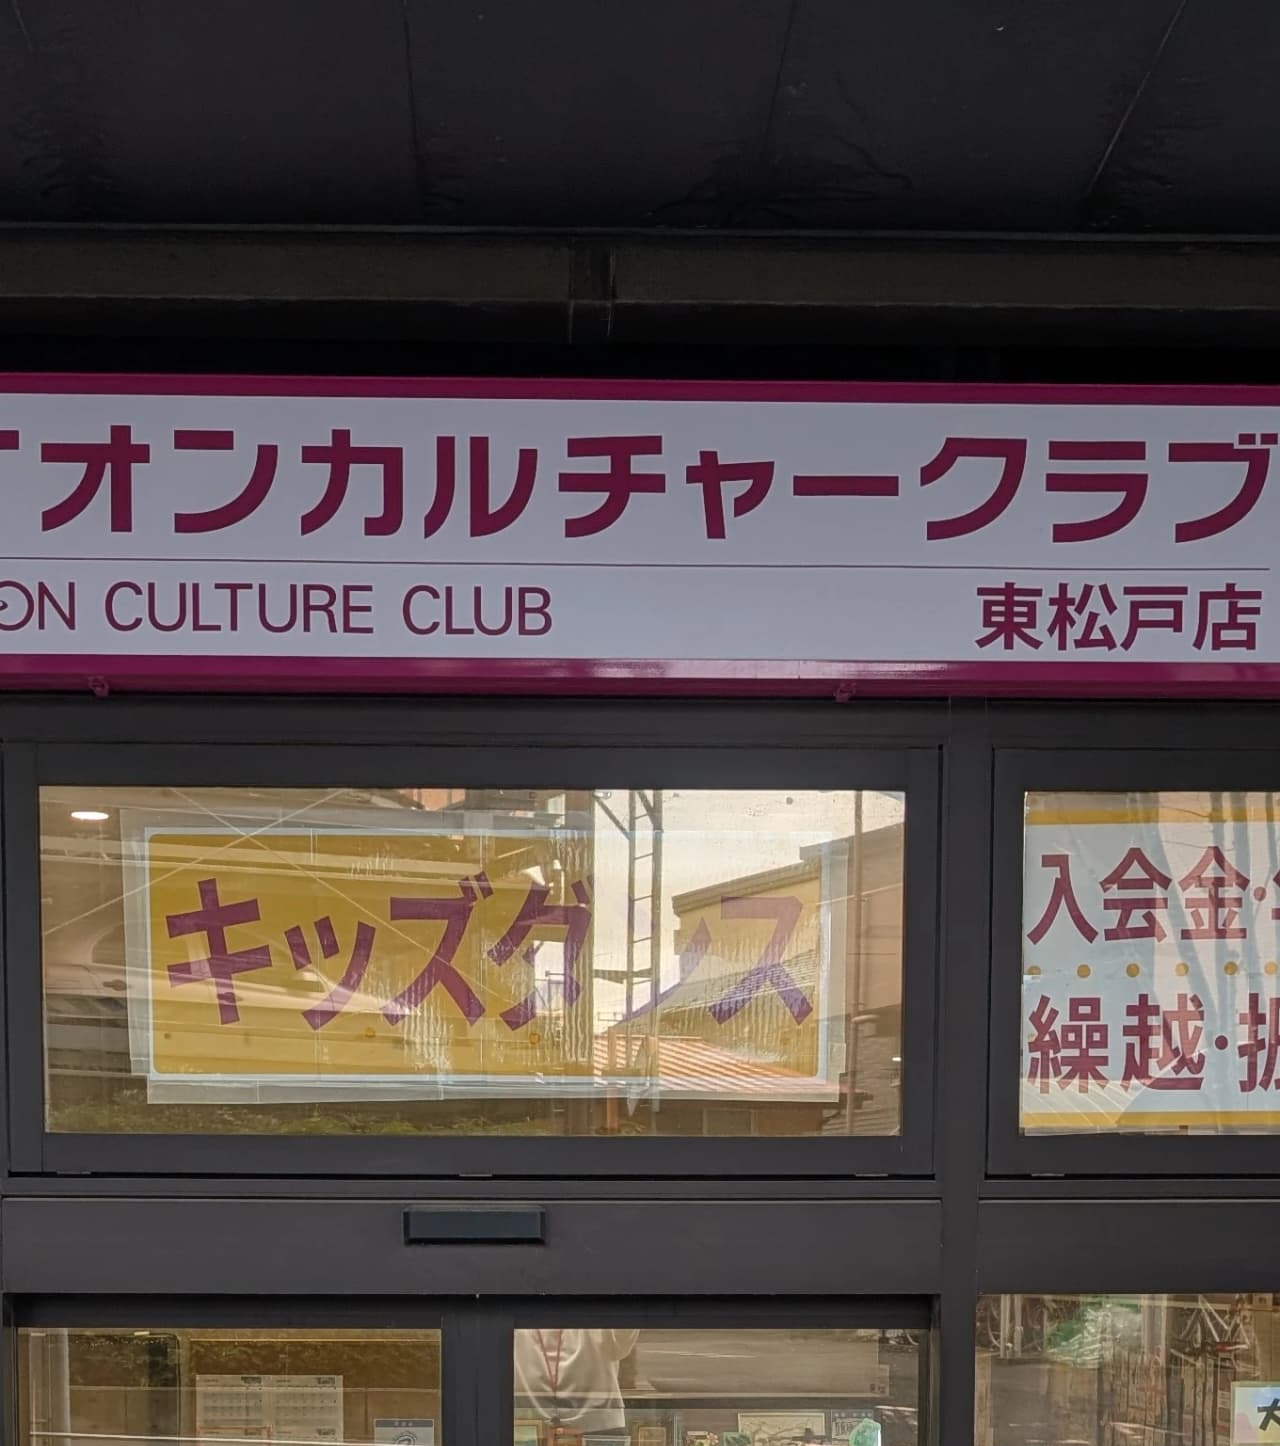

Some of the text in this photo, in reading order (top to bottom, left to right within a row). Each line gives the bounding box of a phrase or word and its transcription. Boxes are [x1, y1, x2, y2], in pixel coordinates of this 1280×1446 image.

[104, 582, 375, 636] CULTURE
[402, 585, 554, 638] CLUB
[975, 582, 1264, 653] 東松戸店
